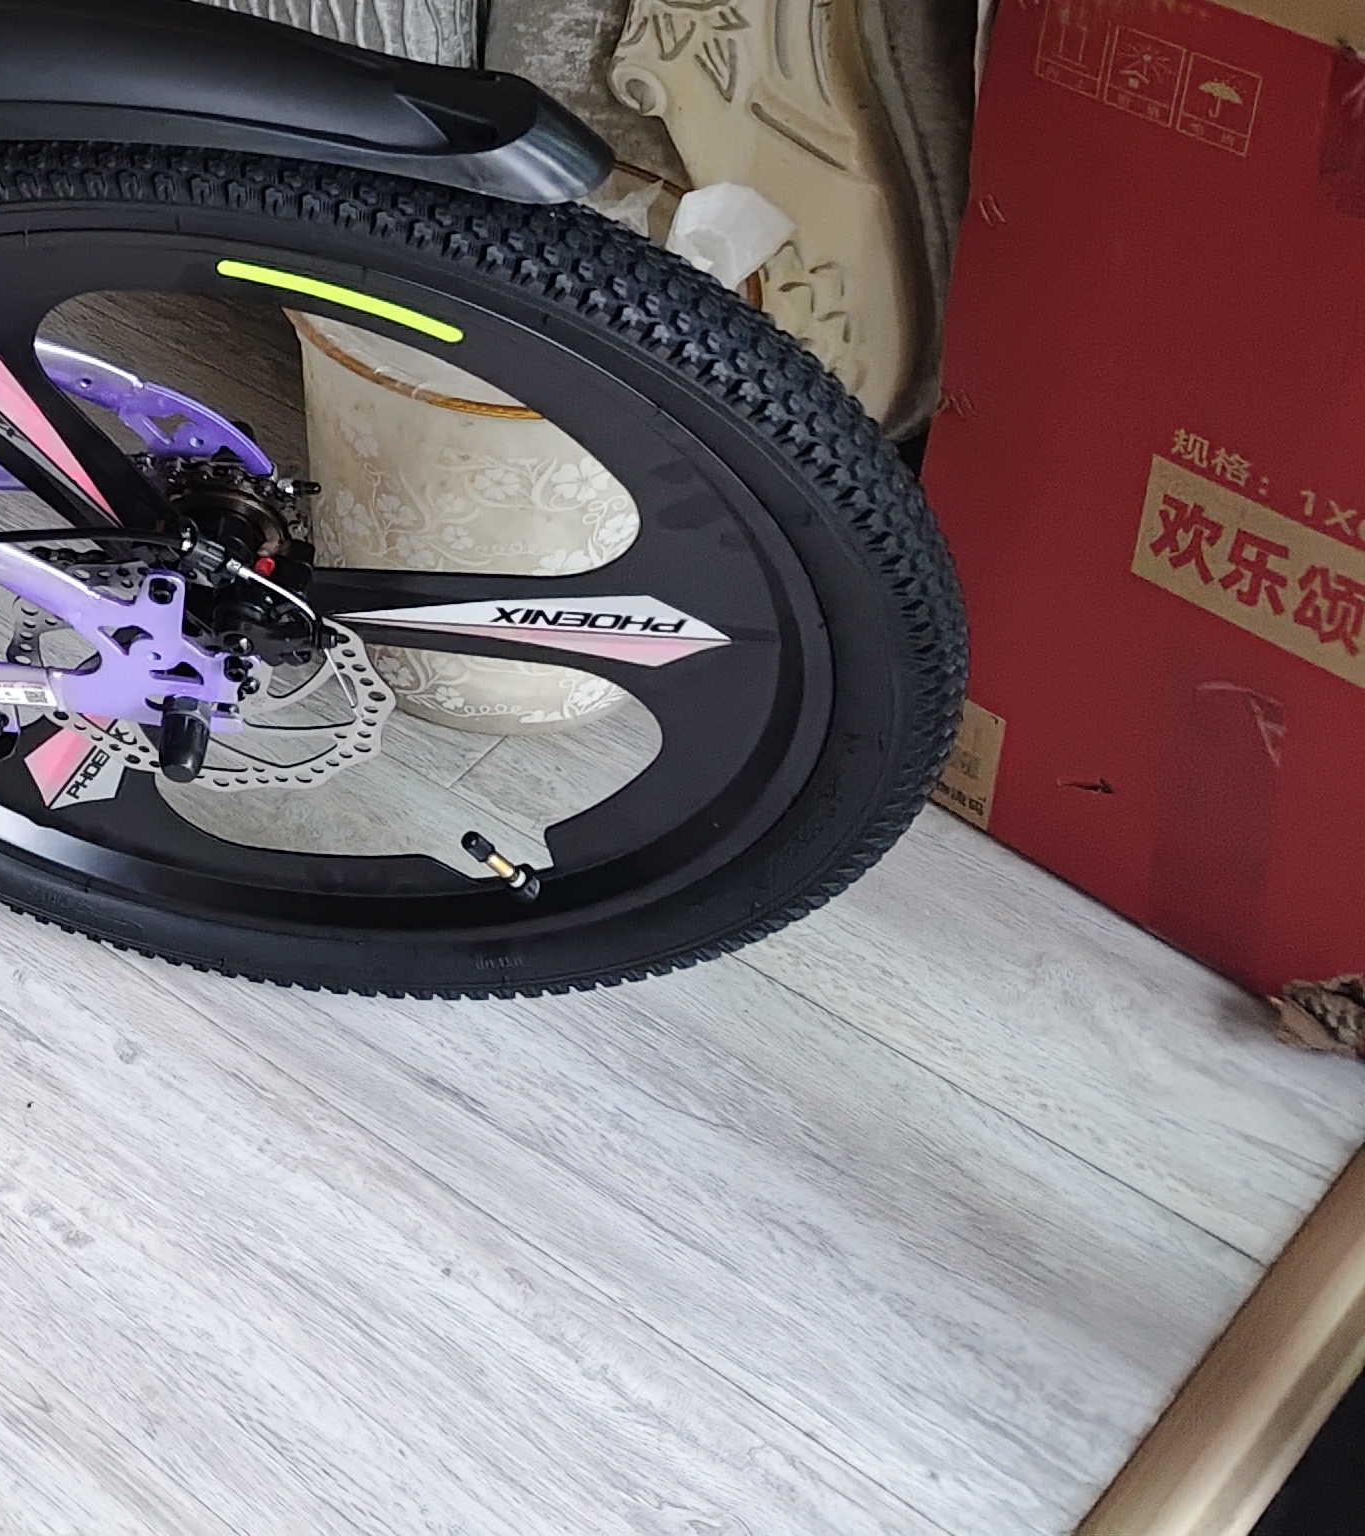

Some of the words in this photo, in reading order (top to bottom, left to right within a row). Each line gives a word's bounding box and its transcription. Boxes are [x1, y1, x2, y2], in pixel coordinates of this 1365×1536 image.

[490, 607, 687, 633] PHOENIX
[1150, 494, 1365, 656] 欢乐颂
